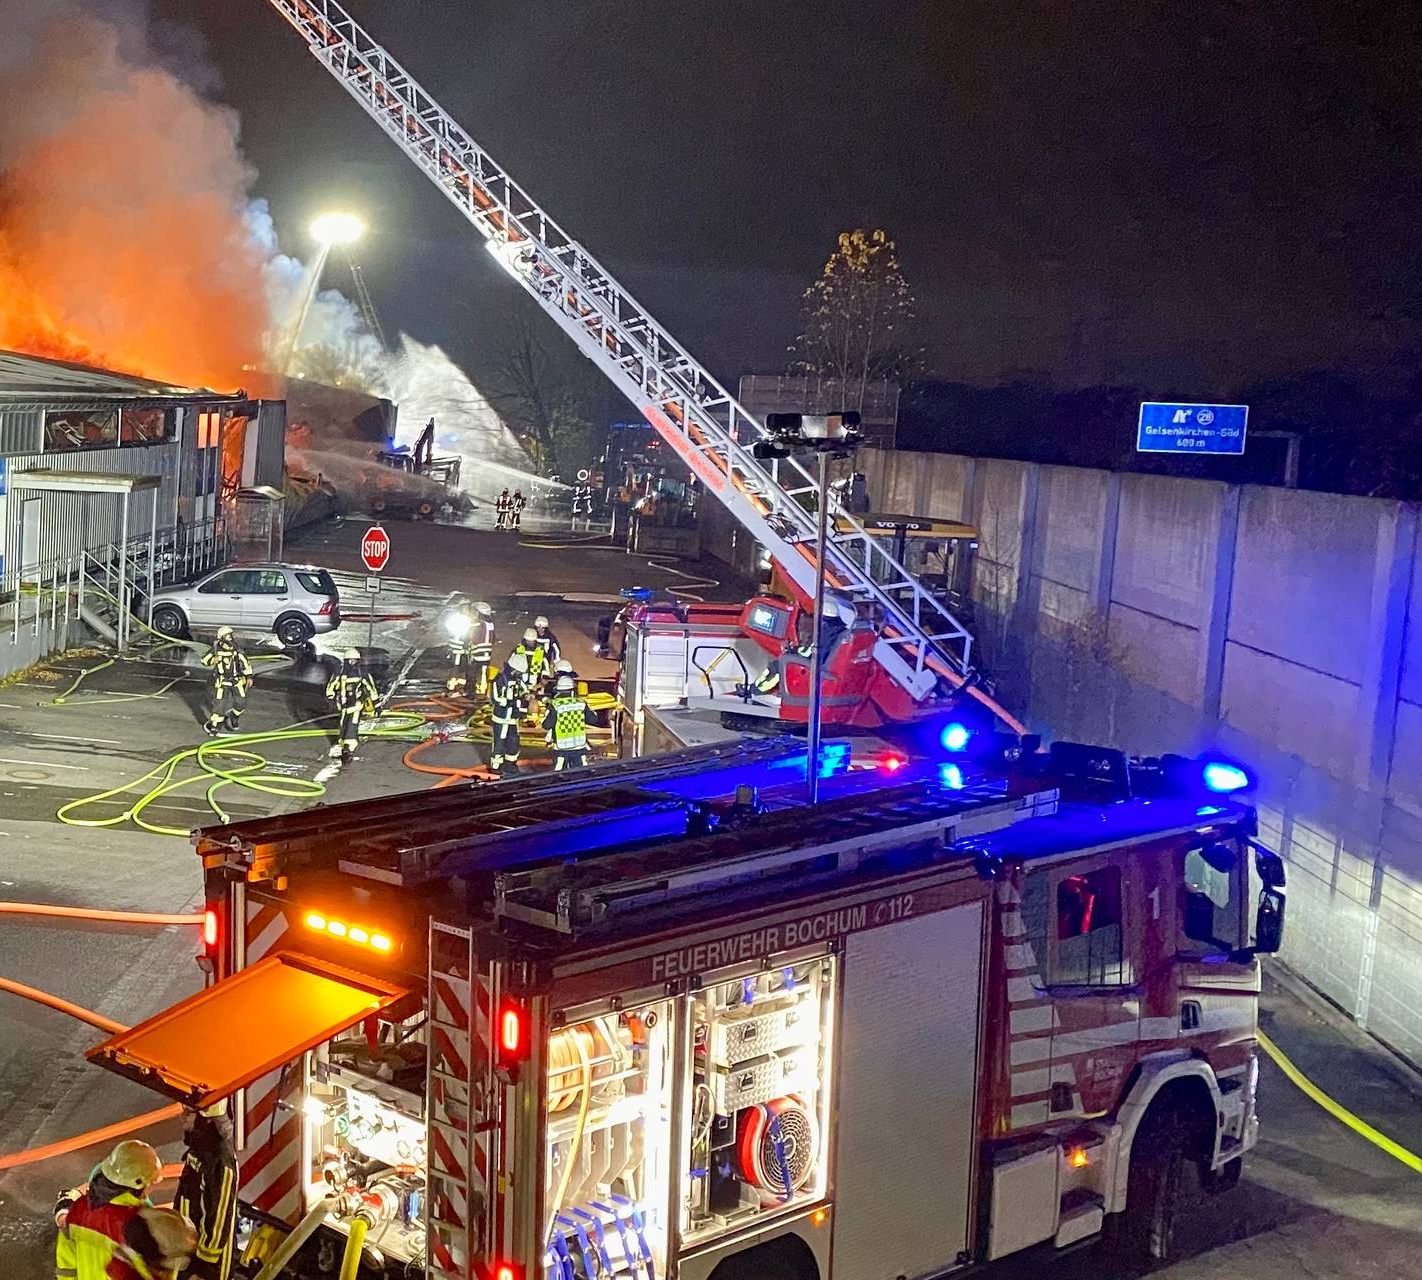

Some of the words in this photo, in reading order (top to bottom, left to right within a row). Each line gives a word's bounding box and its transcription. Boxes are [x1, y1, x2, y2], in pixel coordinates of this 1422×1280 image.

[876, 521, 920, 530] VOVO
[364, 540, 387, 558] STOP
[651, 928, 780, 982] FEUERWEHR
[784, 905, 867, 948] BOCHUM
[887, 894, 914, 920] 112
